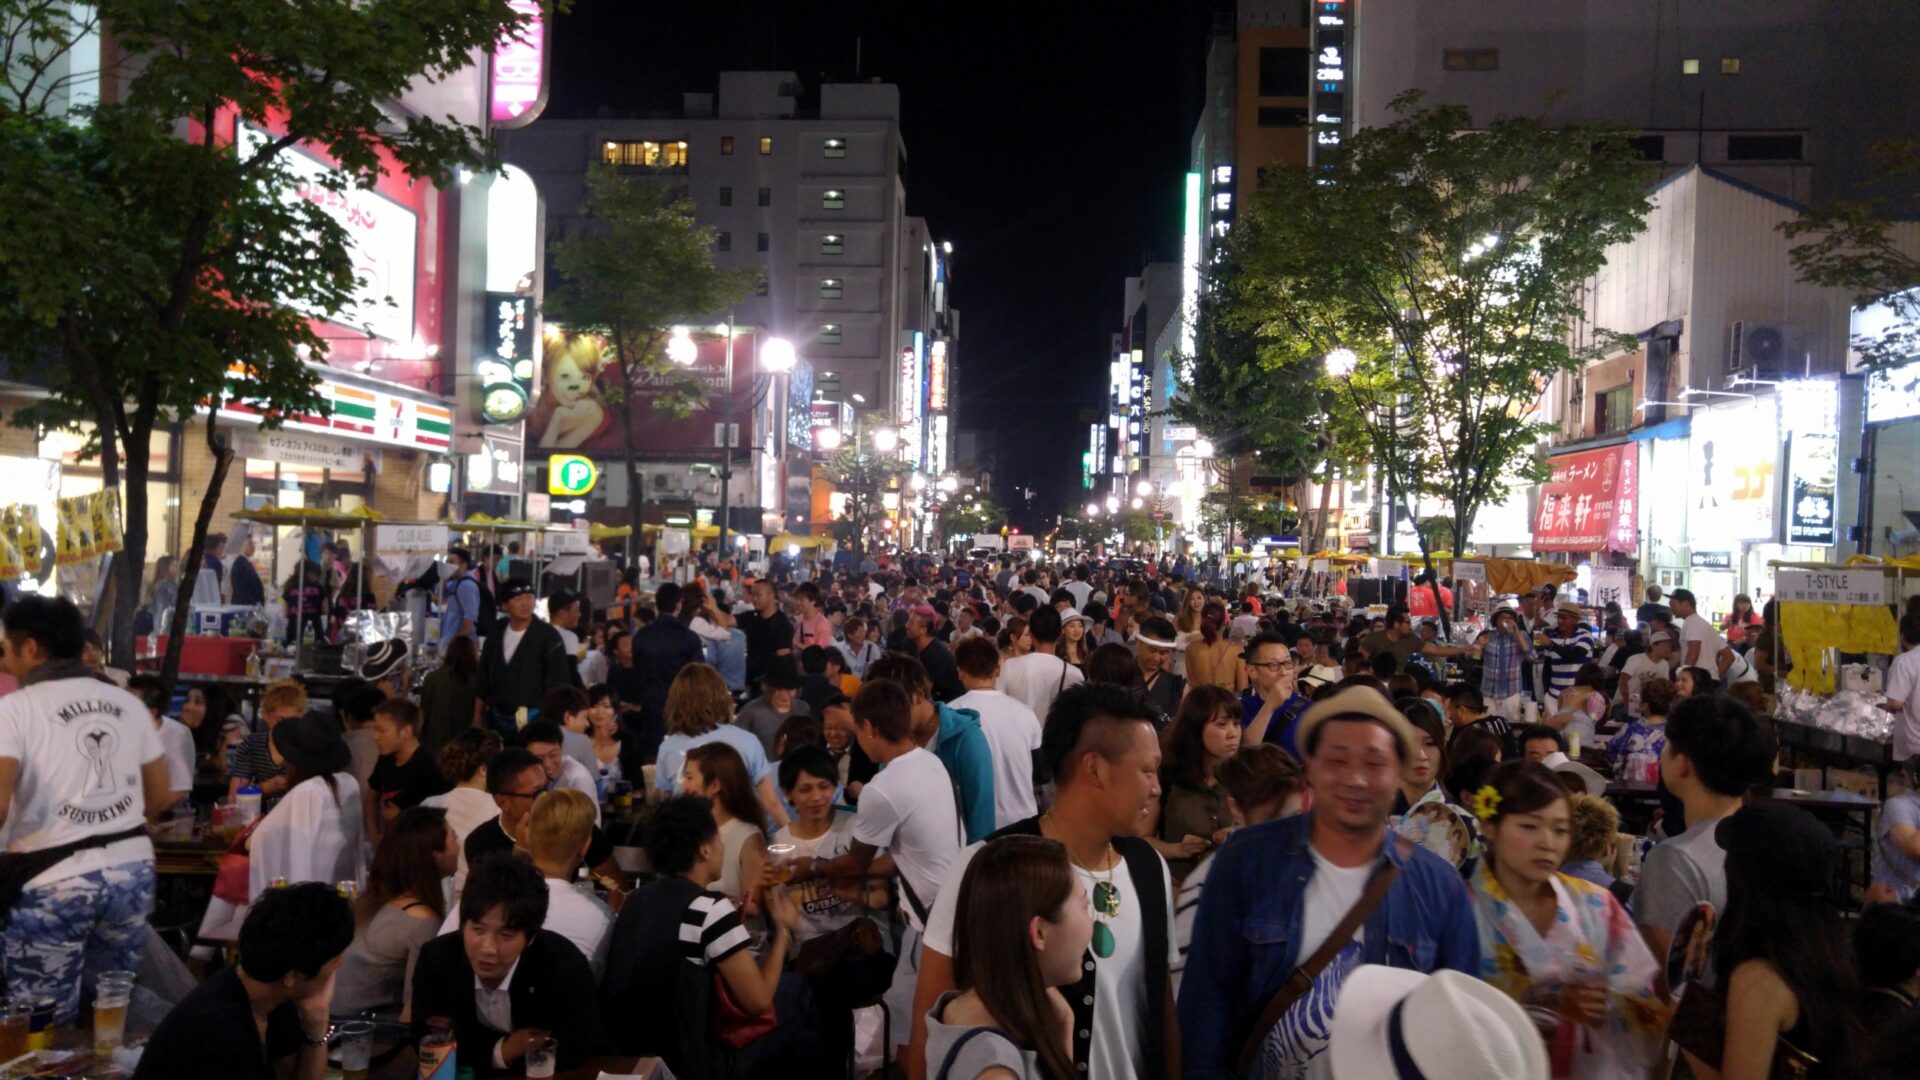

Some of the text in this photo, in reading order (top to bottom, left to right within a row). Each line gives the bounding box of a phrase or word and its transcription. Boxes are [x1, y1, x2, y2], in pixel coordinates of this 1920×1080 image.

[568, 463, 588, 488] P
[1568, 461, 1599, 482] ラーメン
[1539, 492, 1593, 532] 福来軒
[1805, 574, 1848, 590] T-STYLE
[57, 701, 123, 723] MILLION
[59, 794, 133, 824] SUSUKINO
